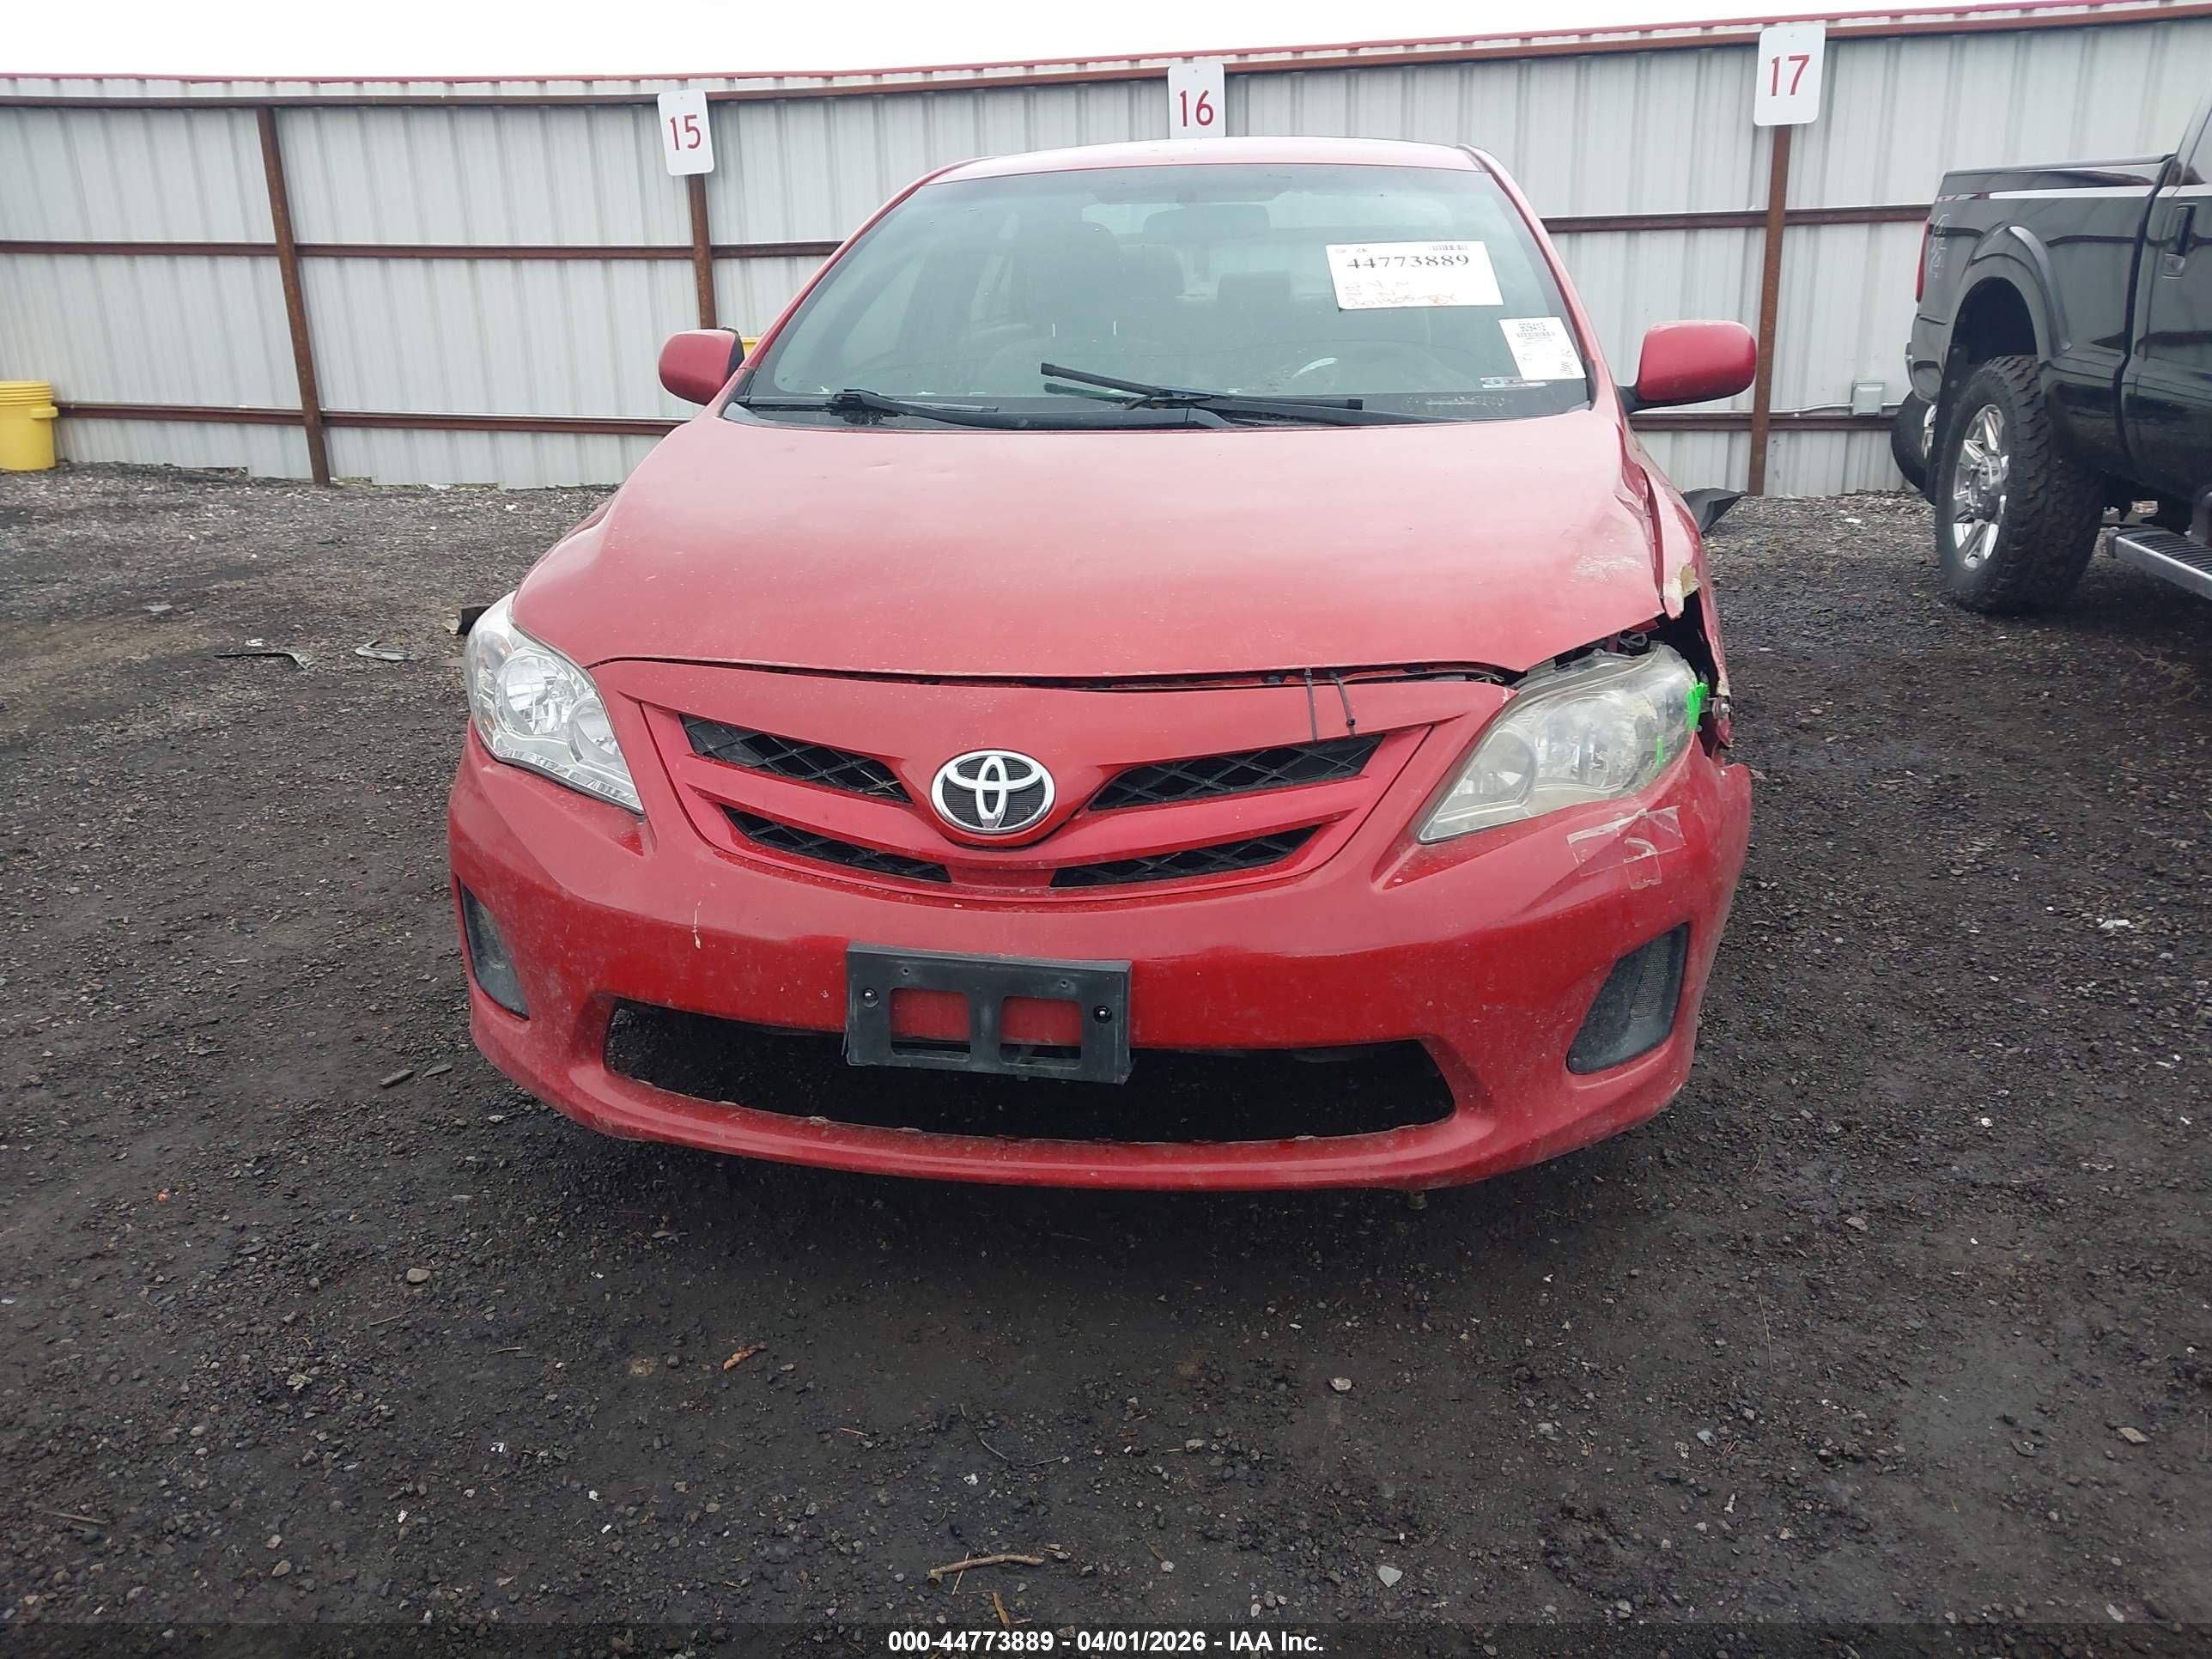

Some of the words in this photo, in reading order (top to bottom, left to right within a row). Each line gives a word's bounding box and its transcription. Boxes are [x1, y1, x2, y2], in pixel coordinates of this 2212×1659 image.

[1771, 54, 1810, 96] 17
[1180, 89, 1214, 127] 16
[669, 113, 702, 151] 15
[1346, 254, 1470, 270] 44773889
